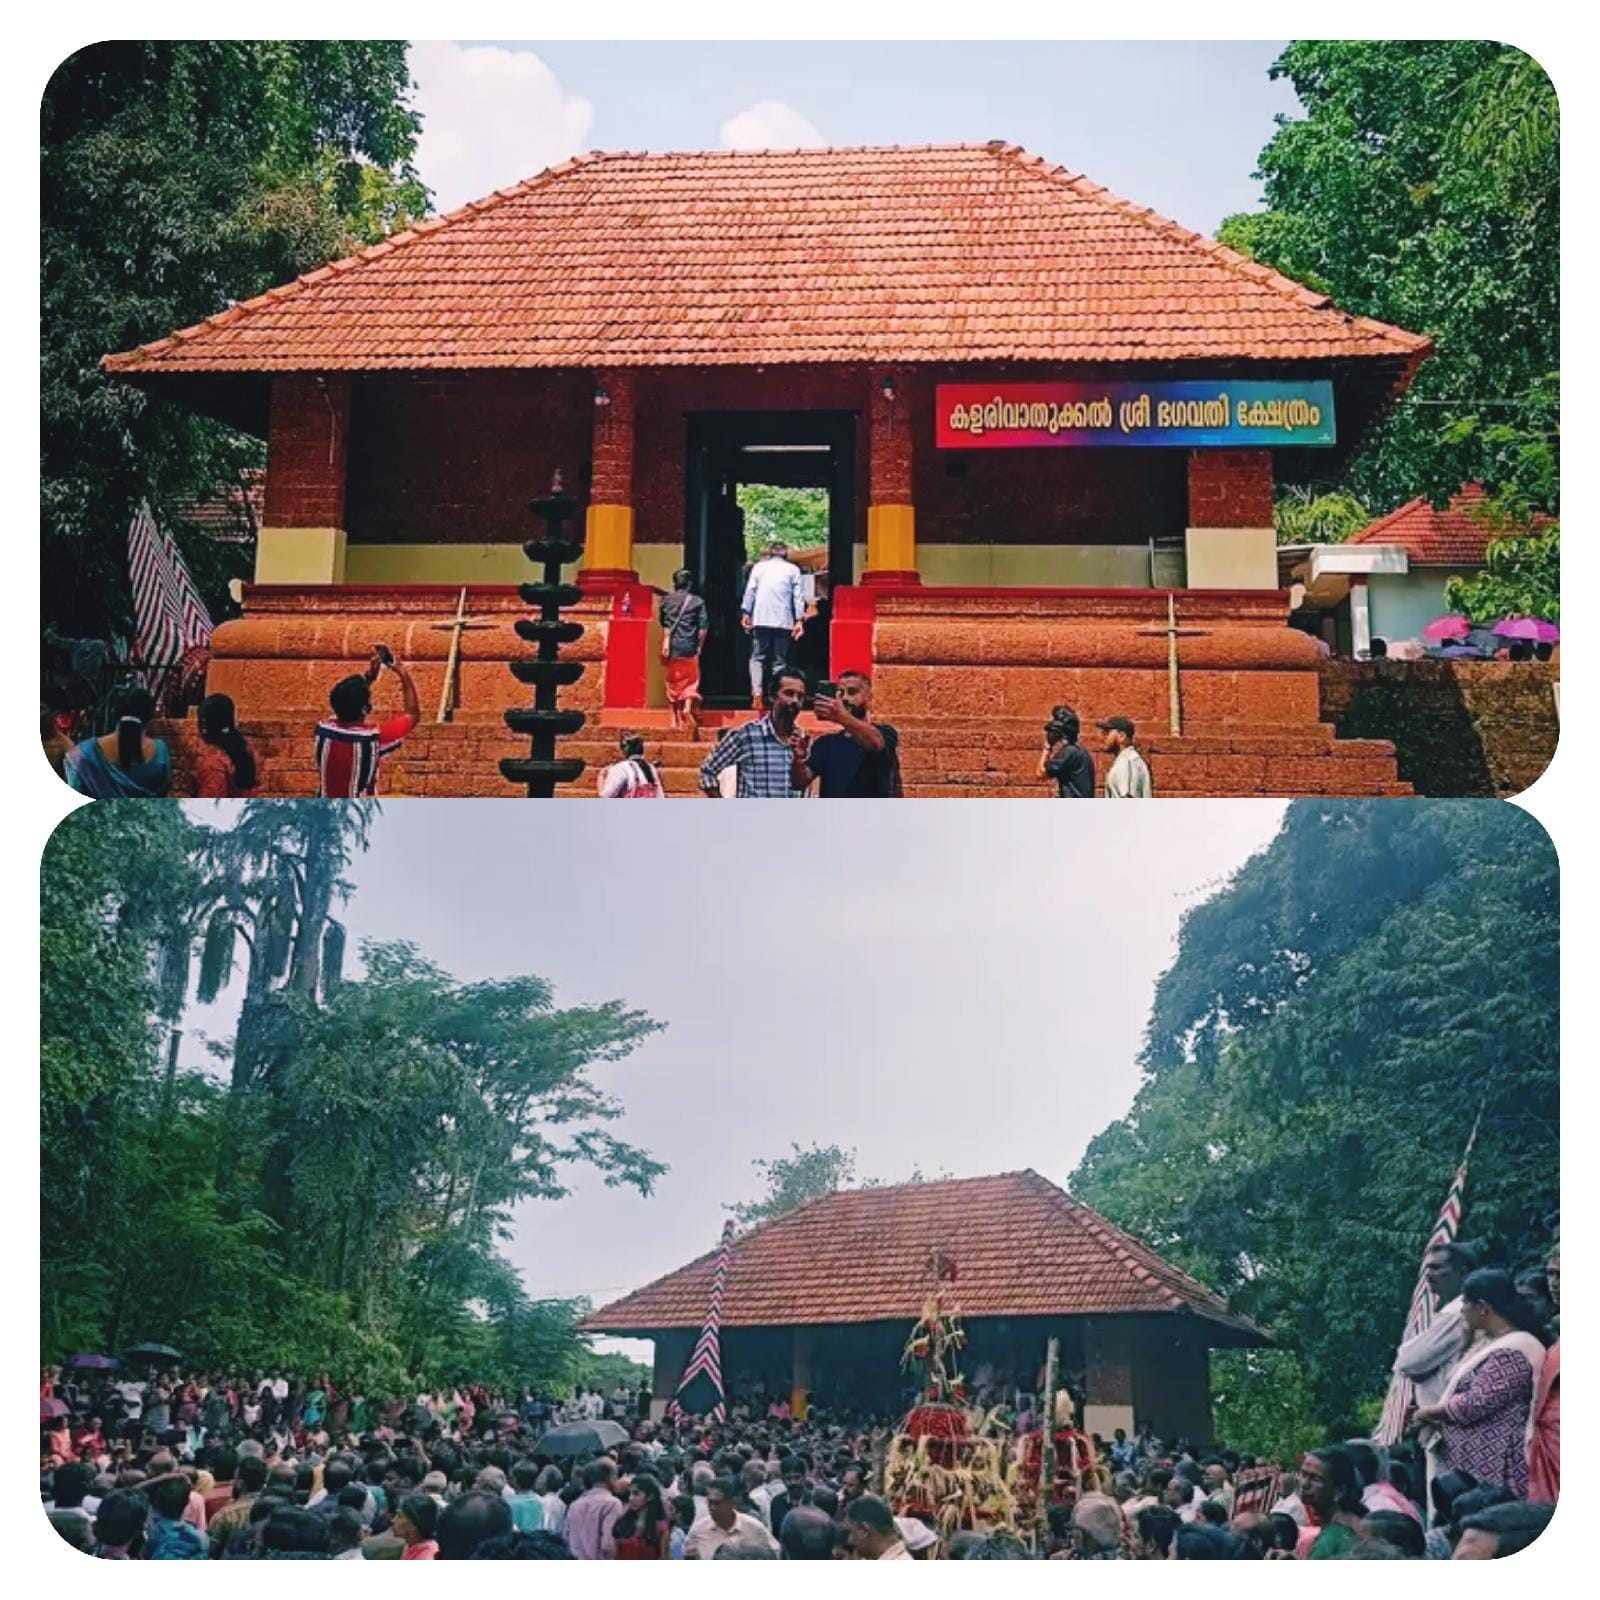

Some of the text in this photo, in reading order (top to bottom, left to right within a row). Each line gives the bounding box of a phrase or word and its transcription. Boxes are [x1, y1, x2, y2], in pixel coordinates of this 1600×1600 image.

[1119, 393, 1151, 433] ശ്രീ
[1157, 392, 1230, 428] ഭഗവതി
[1237, 398, 1320, 432] ക്ഷേത്രം
